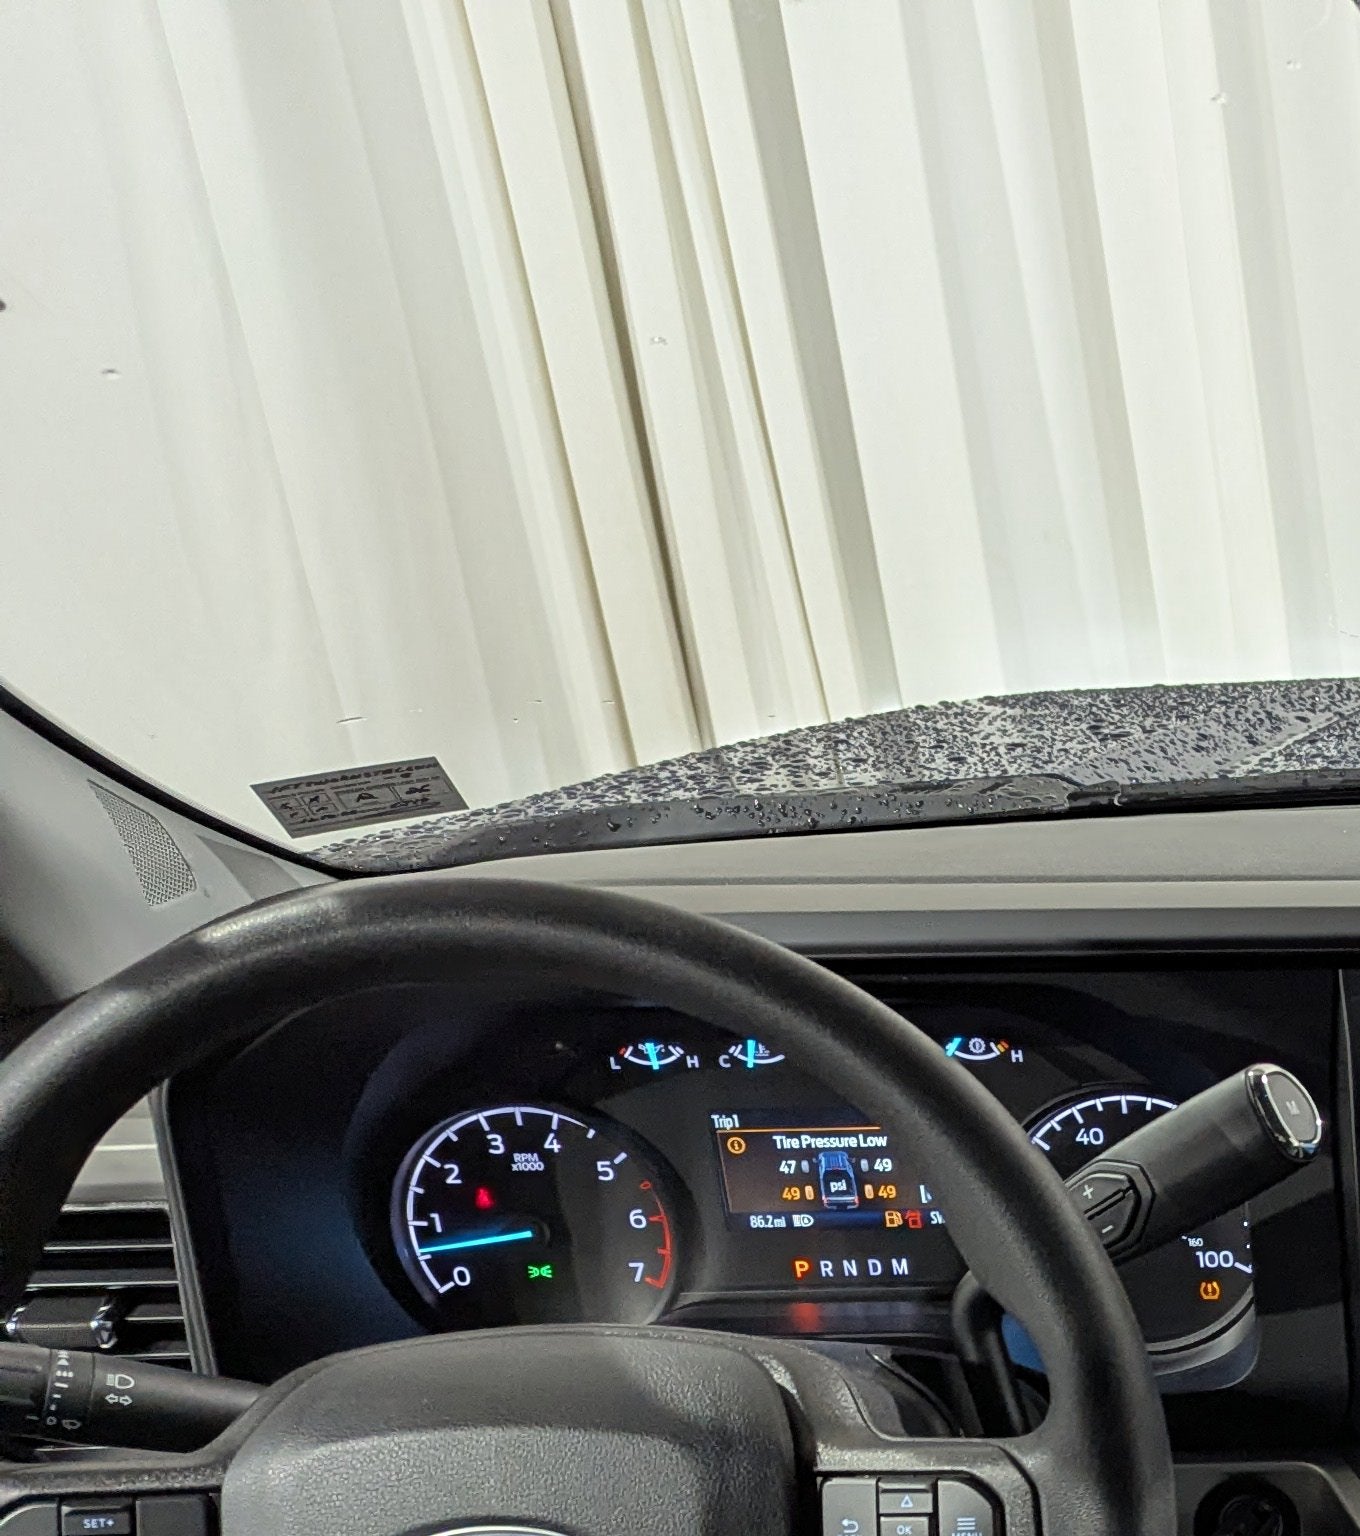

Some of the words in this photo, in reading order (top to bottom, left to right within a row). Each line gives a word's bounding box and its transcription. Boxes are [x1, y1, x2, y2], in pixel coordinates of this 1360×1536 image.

[609, 1056, 622, 1070] L
[686, 1055, 700, 1068] H
[718, 1054, 732, 1068] C
[1011, 1050, 1024, 1063] H
[486, 1133, 506, 1155] 3
[543, 1132, 561, 1153] 4
[773, 1135, 800, 1150] Tire
[801, 1134, 857, 1149] Pressure
[858, 1133, 888, 1148] Low
[1075, 1127, 1104, 1146] 40
[513, 1152, 539, 1163] RPM
[873, 1158, 893, 1172] 49
[443, 1163, 462, 1184] 2
[511, 1161, 545, 1172] x1000
[596, 1160, 615, 1181] 5
[779, 1160, 796, 1174] 47
[782, 1187, 801, 1200] 49
[829, 1178, 847, 1193] psi
[878, 1185, 897, 1199] 49
[429, 1212, 443, 1233] 1
[628, 1208, 648, 1229] 6
[1195, 1250, 1234, 1268] 100
[452, 1265, 472, 1287] 0
[628, 1262, 645, 1283] 7
[794, 1261, 810, 1278] P
[820, 1260, 834, 1277] R
[843, 1259, 858, 1277] N
[868, 1259, 882, 1276] D
[891, 1258, 909, 1275] M
[896, 1524, 914, 1535] OK
